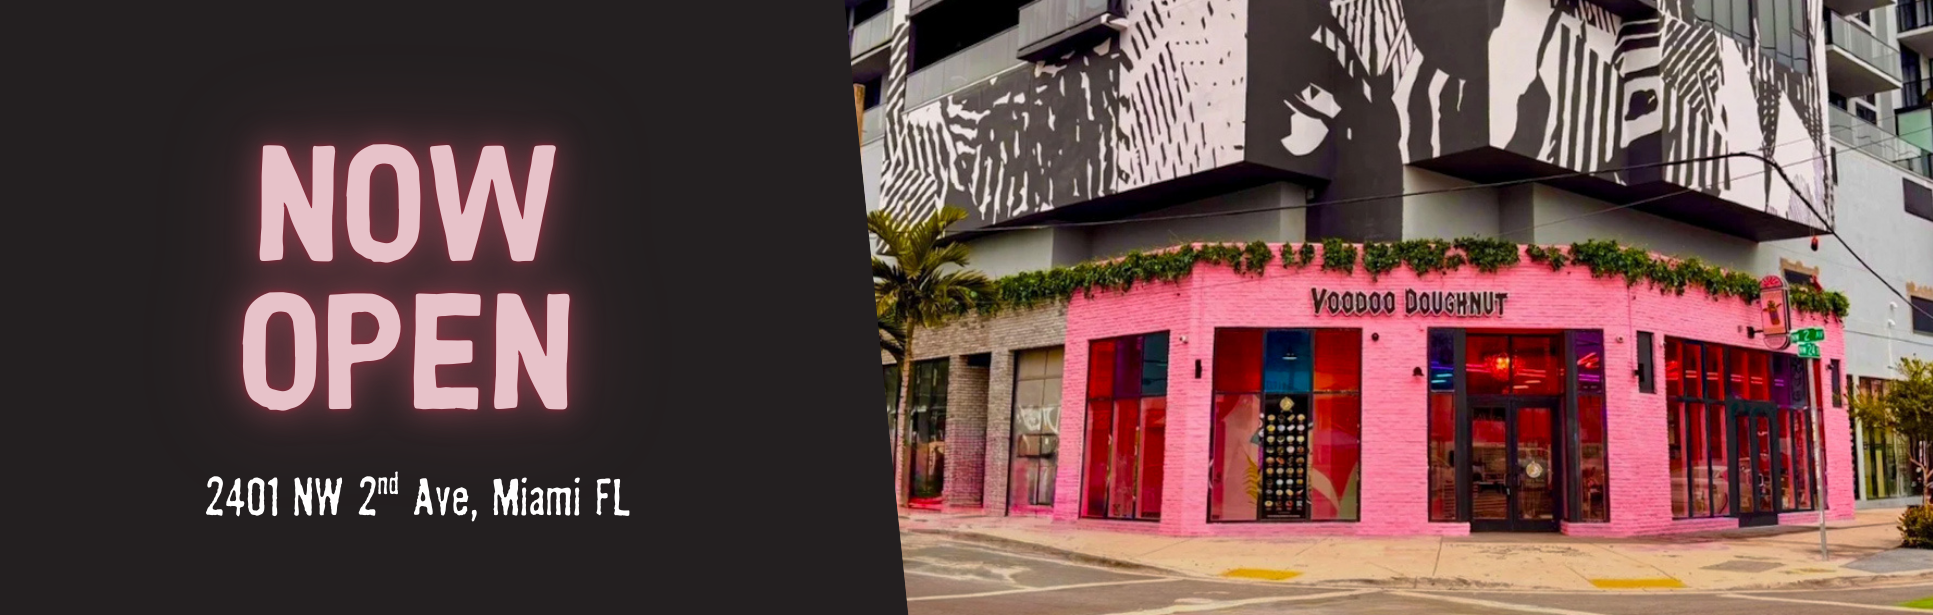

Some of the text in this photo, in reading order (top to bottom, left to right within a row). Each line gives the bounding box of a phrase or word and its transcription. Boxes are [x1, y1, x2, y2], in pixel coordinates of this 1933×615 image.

[1311, 287, 1509, 317] VOODOO DOUGHNUT
[1803, 329, 1811, 341] 2
[1807, 344, 1816, 356] 24
